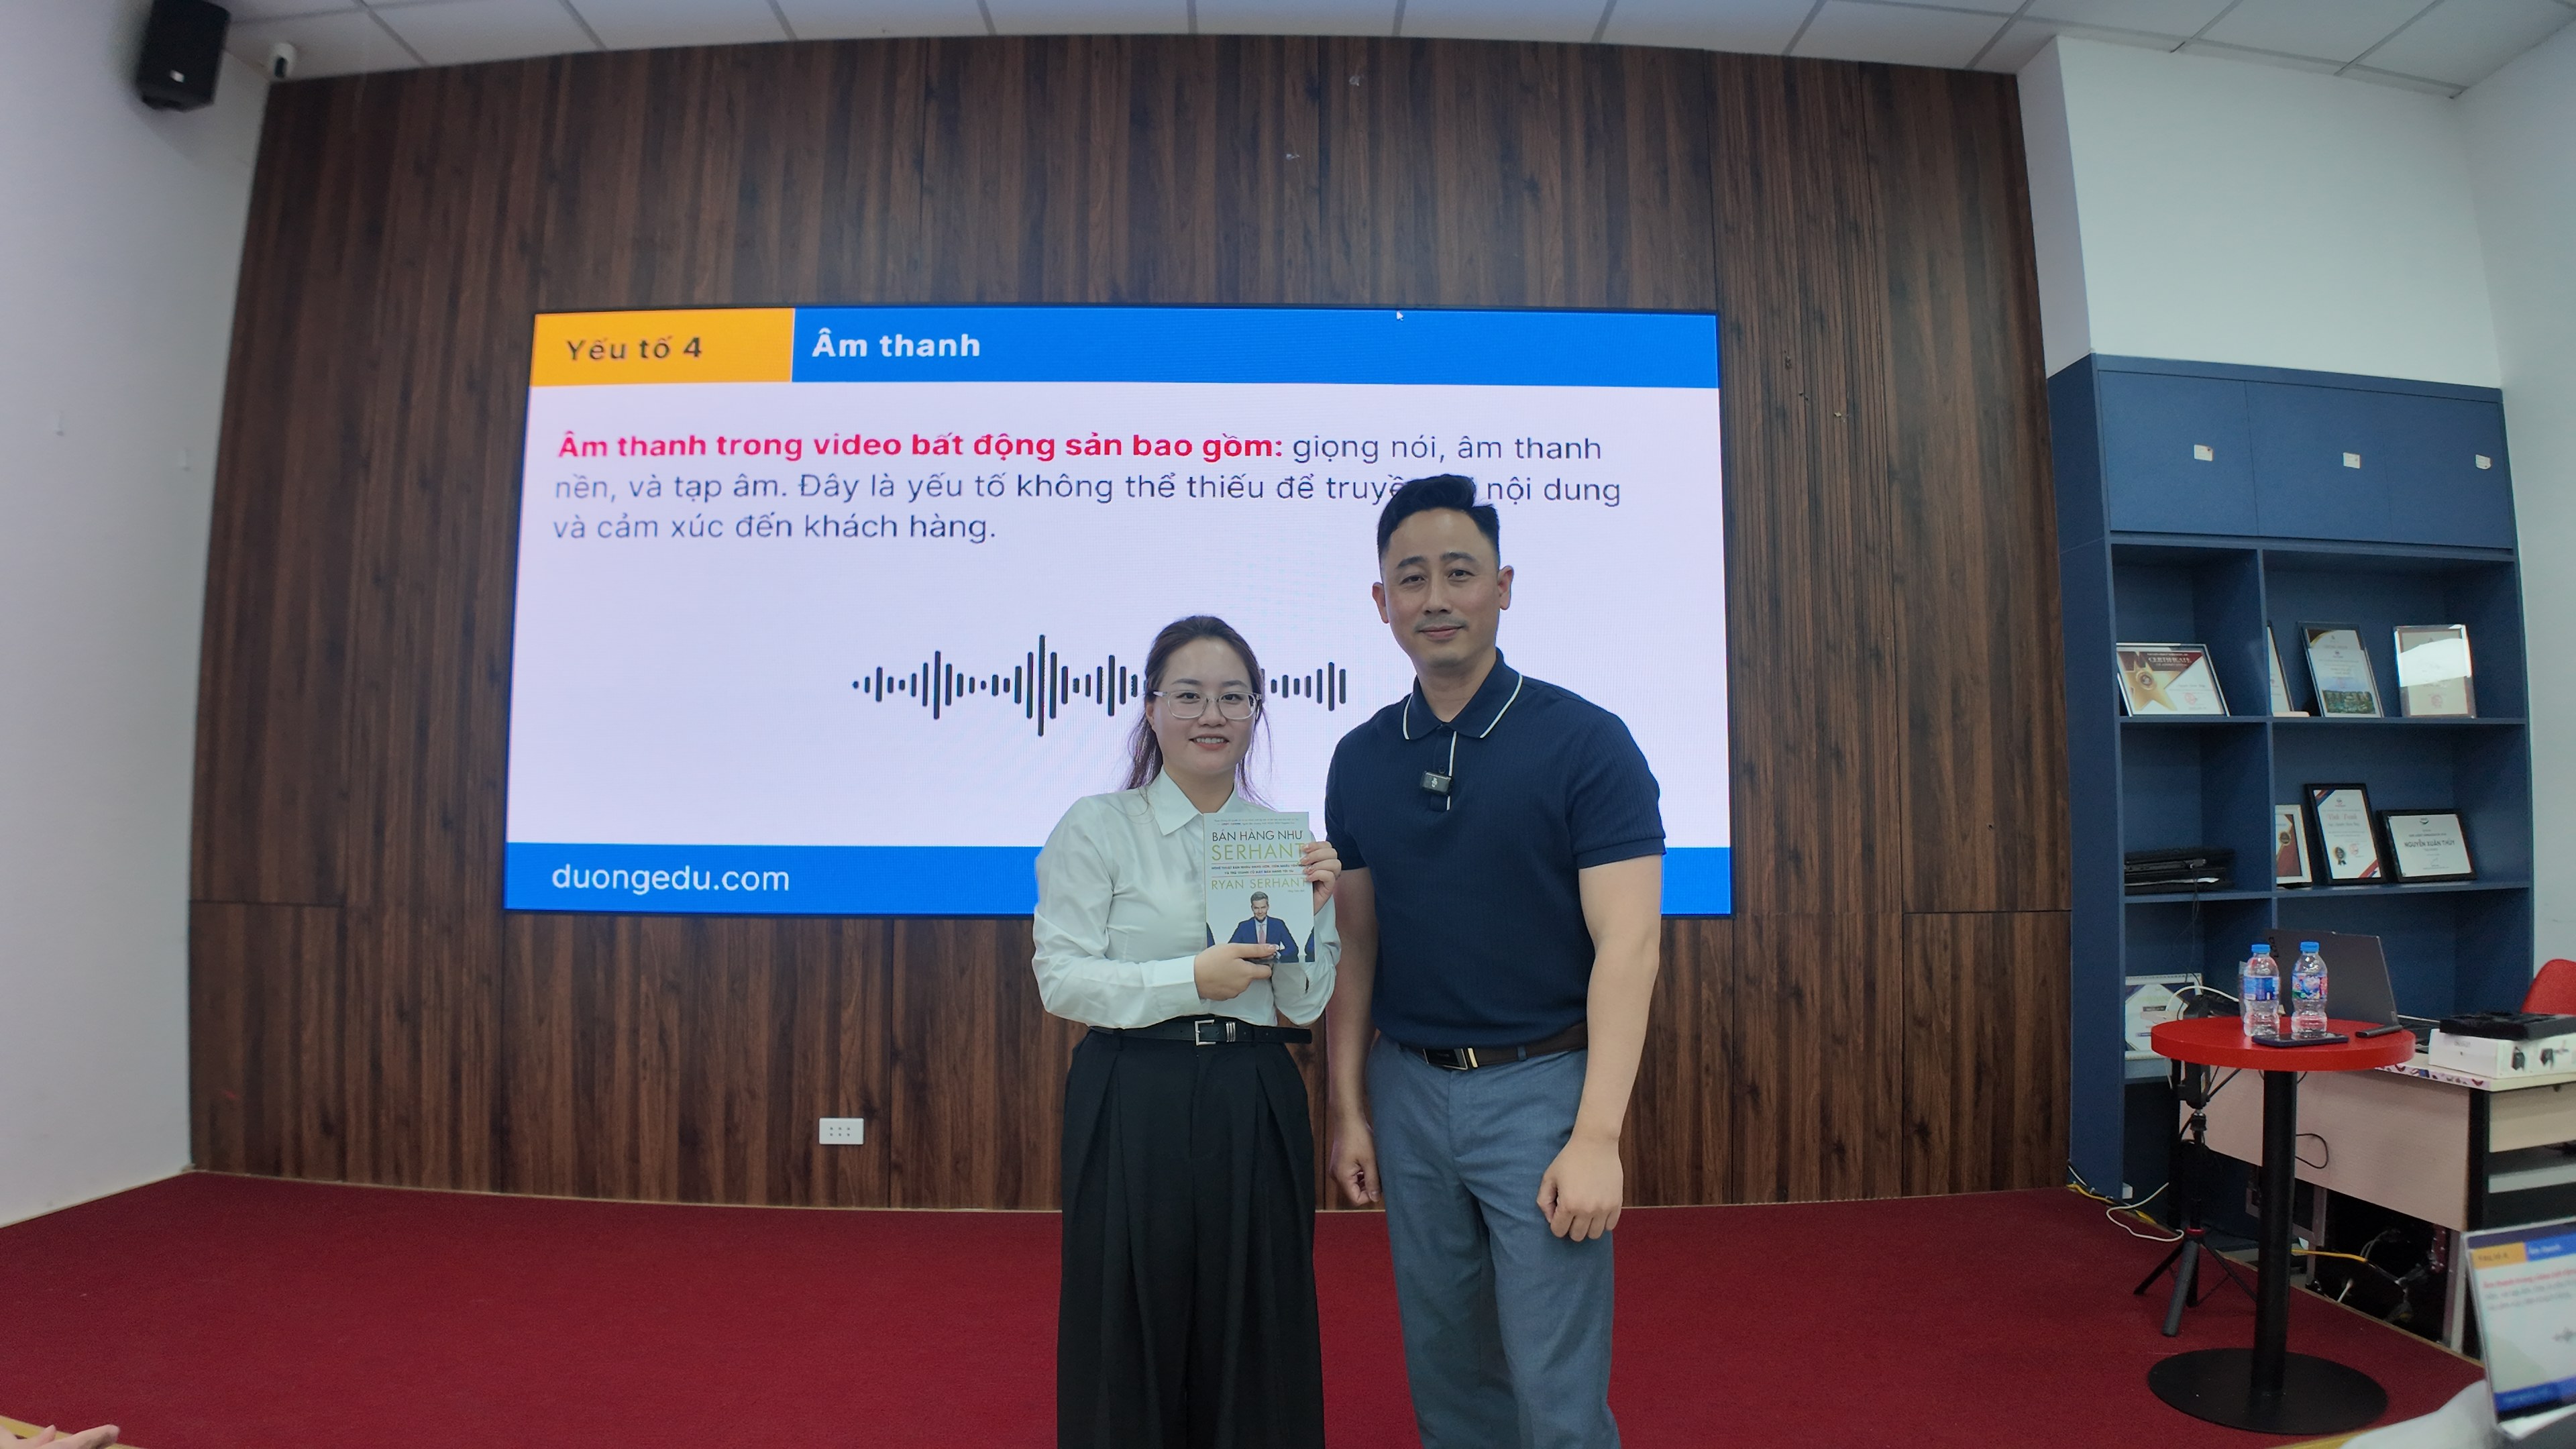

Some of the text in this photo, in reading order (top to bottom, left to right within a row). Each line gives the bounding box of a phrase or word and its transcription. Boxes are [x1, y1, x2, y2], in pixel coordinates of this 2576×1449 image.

[567, 335, 702, 361] Yếu tố 4
[812, 327, 980, 358] Âm thanh
[558, 431, 1601, 464] Âm thanh trong video bất động sản bao gồm: giọng nói, âm thanh
[555, 471, 1620, 508] nền, và tạp âm. Đây là yếu tố không thể thiếu để truyề nội dung
[553, 511, 996, 544] và cảm xúc đến khách hàng.
[1212, 828, 1303, 841] BÁN HÀNG NHƯ
[1212, 843, 1304, 861] SERHANT
[551, 863, 790, 896] duongedu.com
[1212, 877, 1307, 890] RYAN SERHANT
